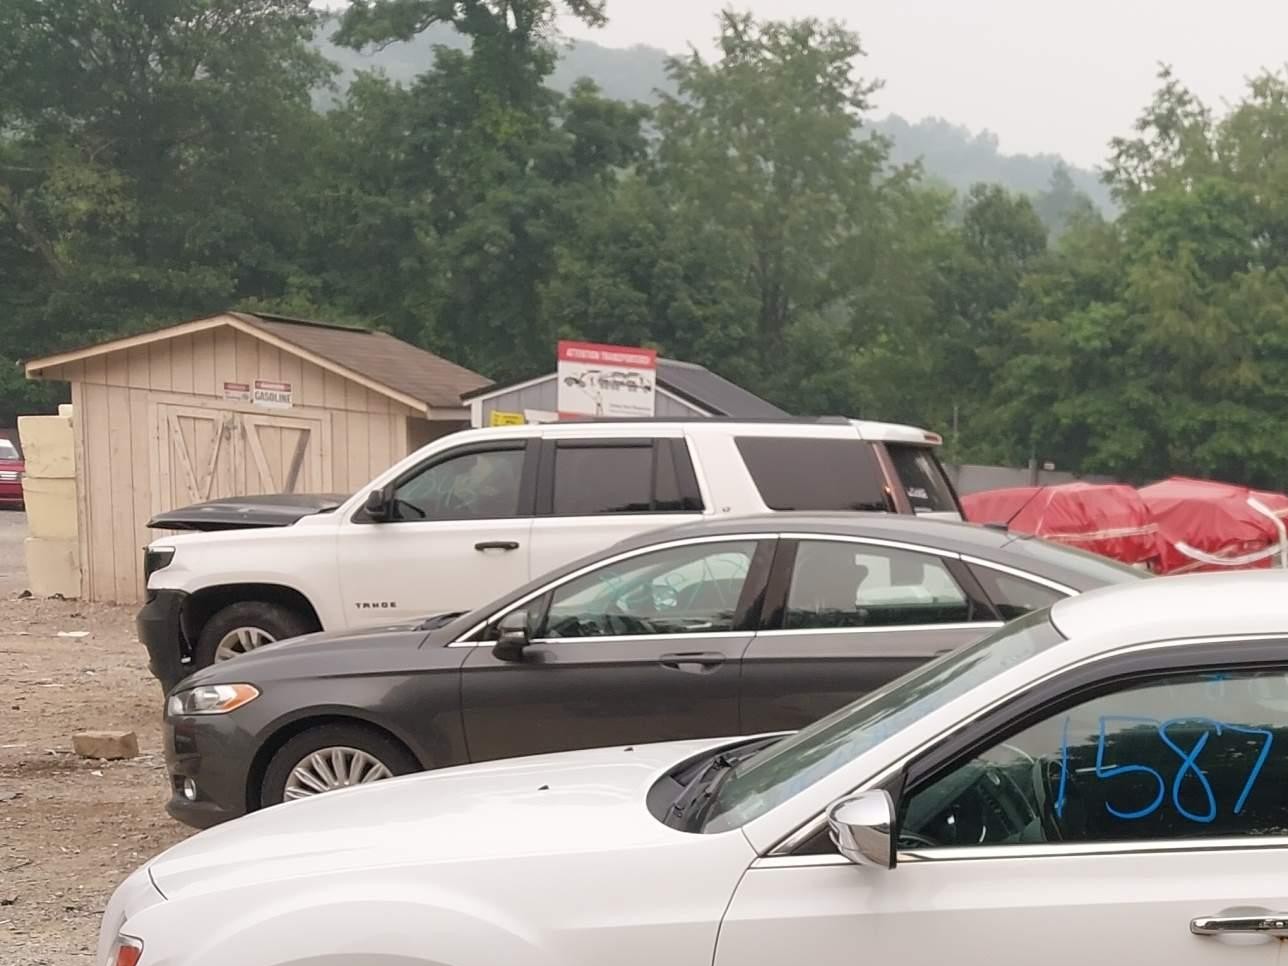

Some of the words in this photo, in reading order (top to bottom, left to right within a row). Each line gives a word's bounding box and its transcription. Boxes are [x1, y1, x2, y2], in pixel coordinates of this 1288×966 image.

[255, 391, 290, 404] GASOLINE
[355, 601, 398, 609] TAHOE
[1054, 715, 1273, 823] 1587
